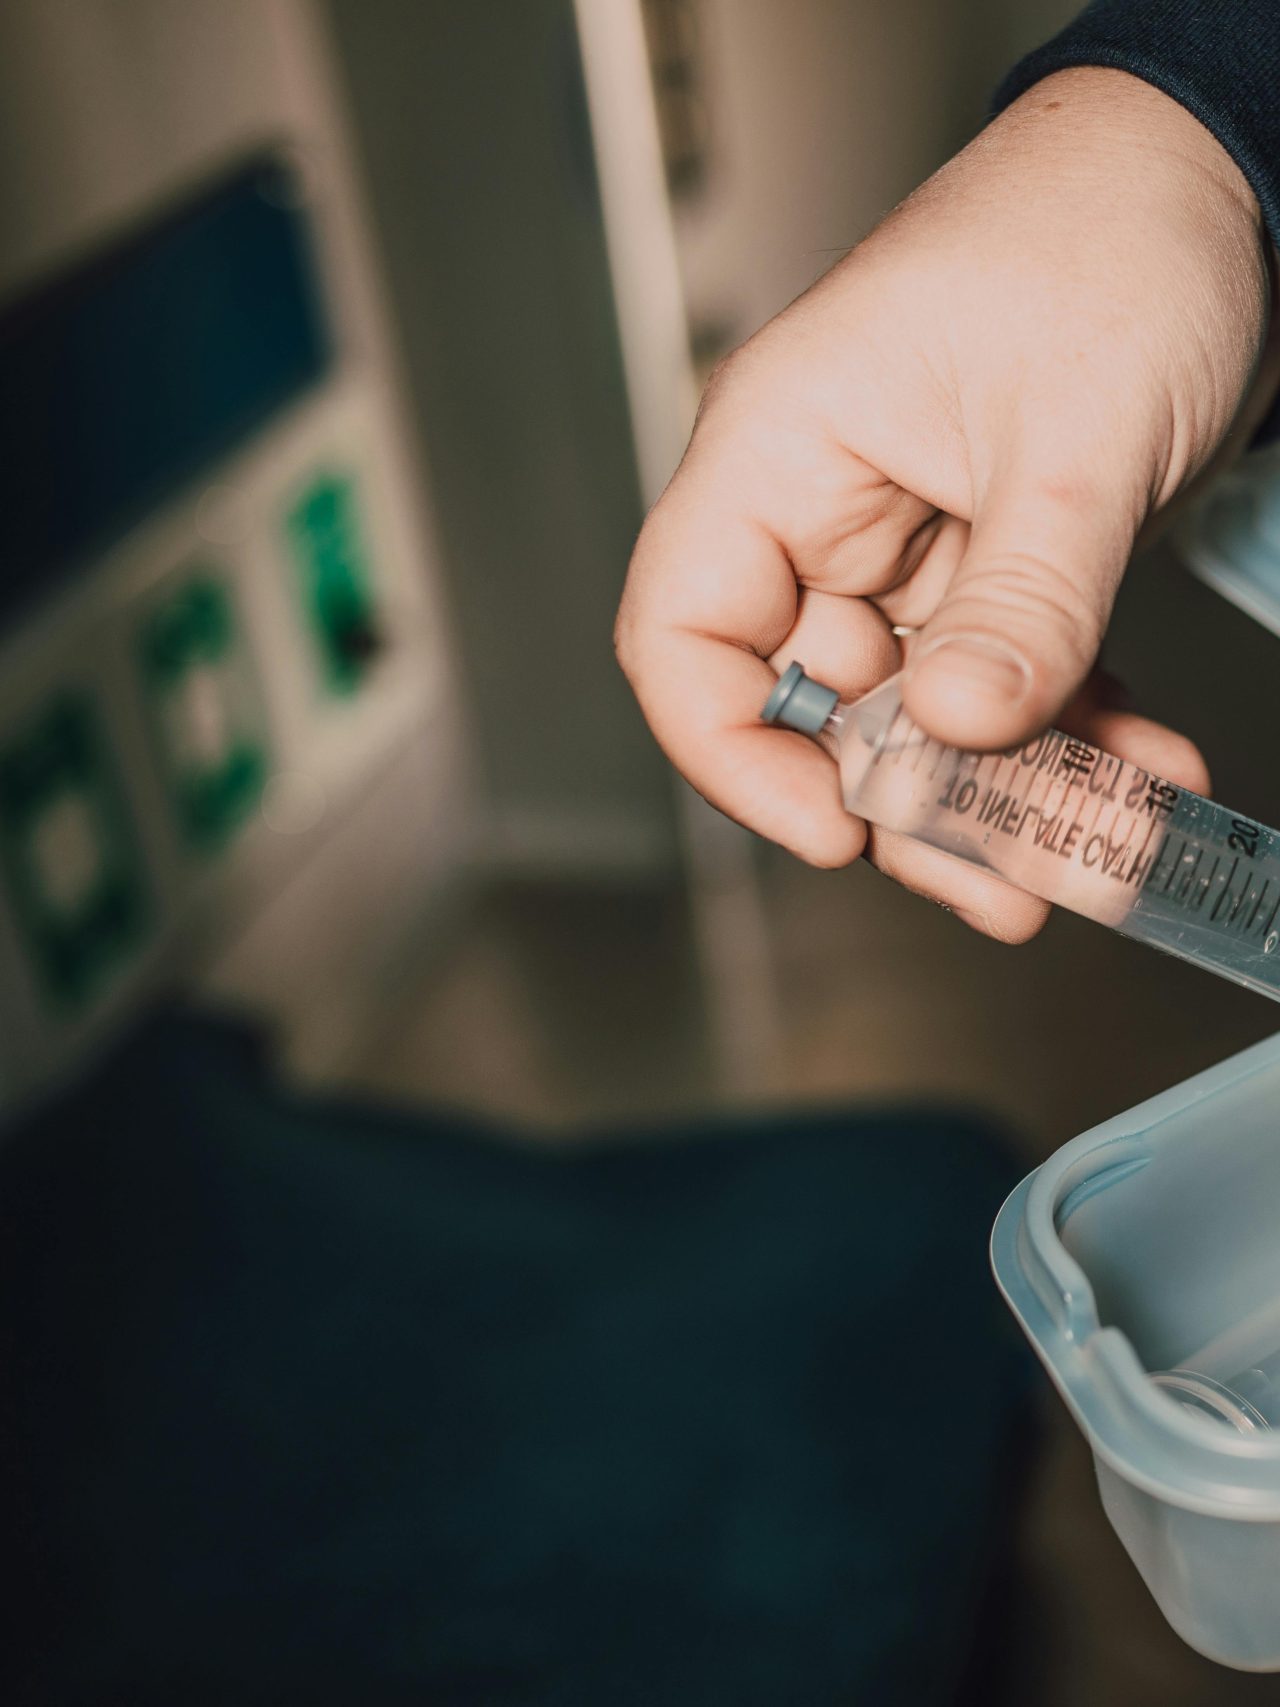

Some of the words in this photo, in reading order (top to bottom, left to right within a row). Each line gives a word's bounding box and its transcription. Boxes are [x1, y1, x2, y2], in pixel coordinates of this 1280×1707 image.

[1063, 744, 1095, 774] 10
[1146, 780, 1178, 813] 15
[1227, 819, 1259, 858] 20
